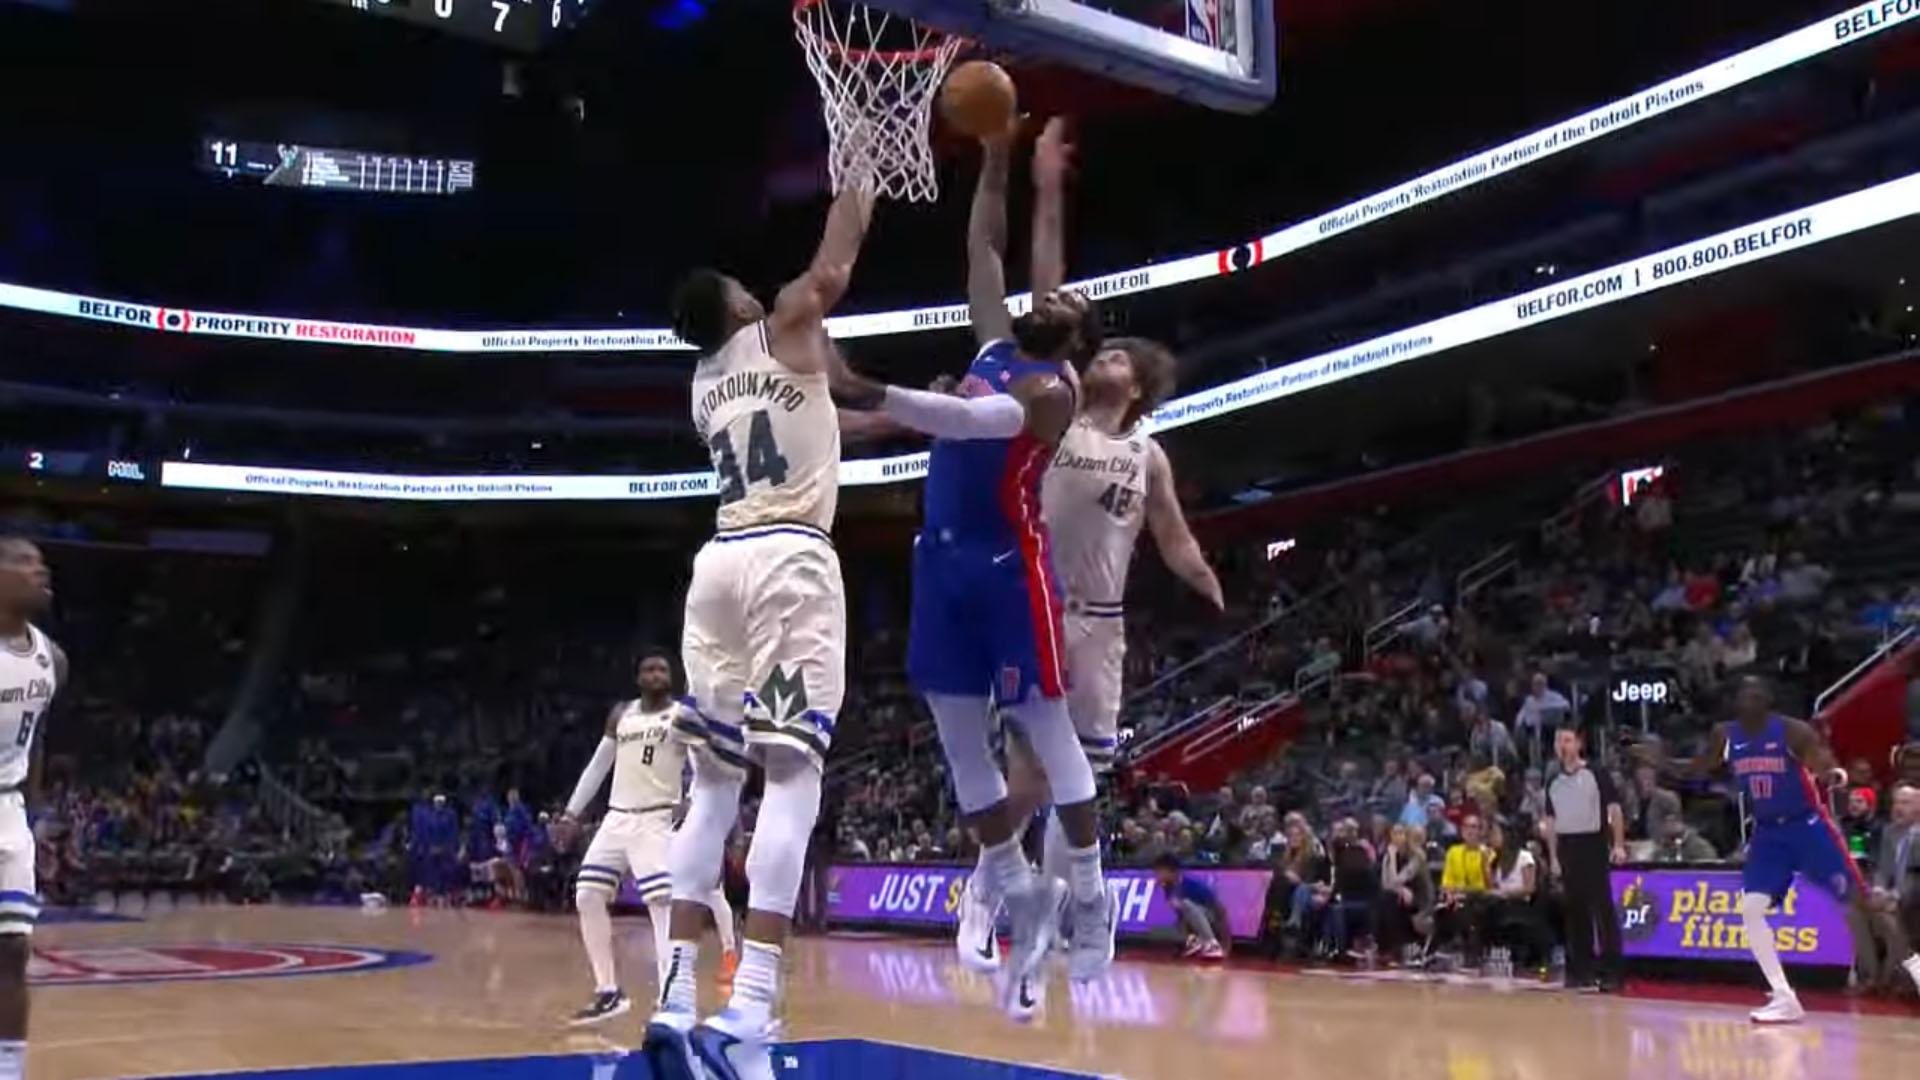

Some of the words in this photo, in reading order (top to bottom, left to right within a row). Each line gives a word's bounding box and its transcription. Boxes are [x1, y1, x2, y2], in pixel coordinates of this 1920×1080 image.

[492, 1, 510, 32] 7
[211, 142, 238, 166] 11
[1319, 209, 1360, 234] Official
[1362, 191, 1411, 219] Property
[1413, 162, 1487, 200] Restoration
[1491, 143, 1541, 170] Partner
[1544, 132, 1559, 149] of
[1562, 125, 1585, 143] the
[1590, 101, 1641, 132] Detroit
[1645, 80, 1704, 112] Pistons
[1517, 274, 1623, 319] BELFOR.COM
[1653, 218, 1813, 280] 800.800.BELFOR
[79, 299, 151, 323] BELFOR
[195, 315, 291, 336] PROPERTY
[296, 323, 416, 345] RESTORATION
[699, 371, 805, 431] TOKOUNMPO
[710, 409, 789, 505] 34
[629, 477, 708, 494] BELFOR.COM
[1612, 680, 1667, 703] Jeep
[869, 874, 945, 913] JUST
[1668, 881, 1798, 922] plat
[1624, 905, 1651, 929] pf
[1680, 914, 1819, 952] fitnss
